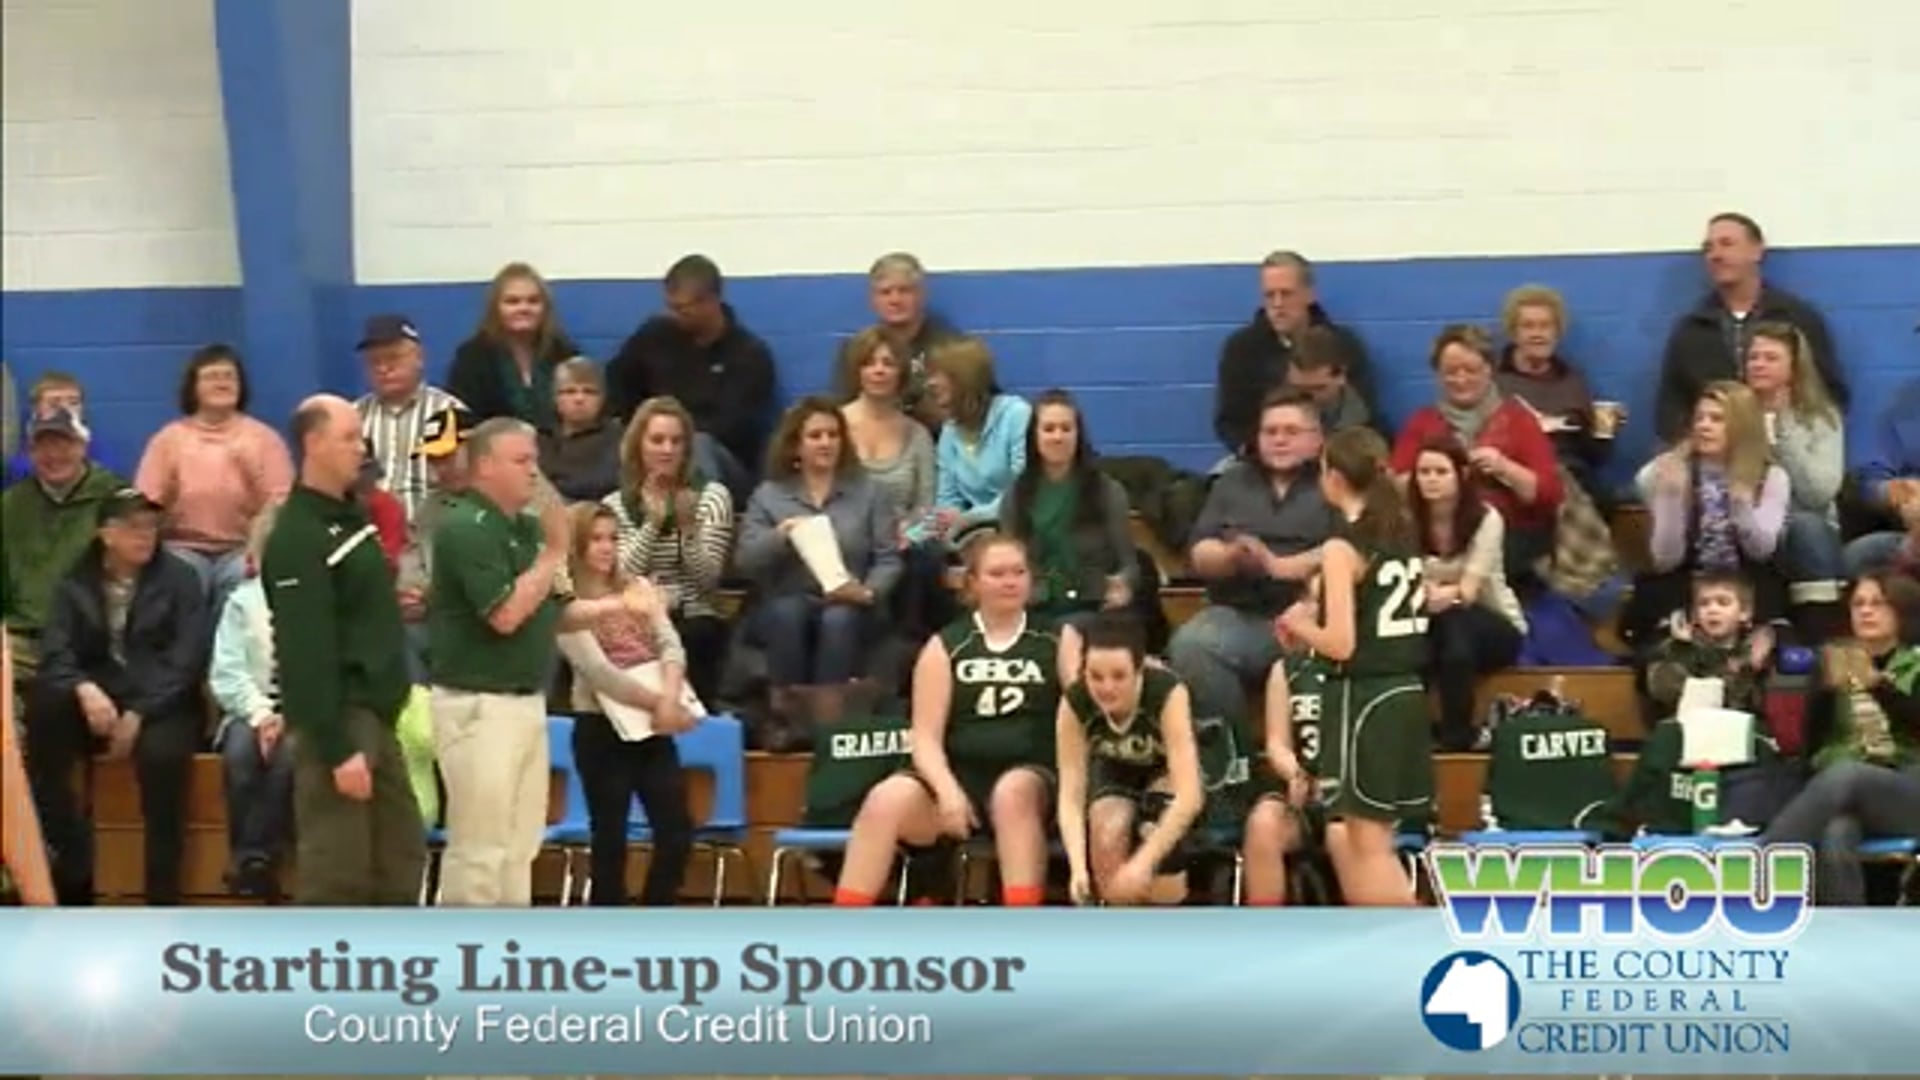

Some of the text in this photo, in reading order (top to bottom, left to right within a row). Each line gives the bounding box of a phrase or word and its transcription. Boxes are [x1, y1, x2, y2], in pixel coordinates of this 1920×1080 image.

[1376, 557, 1429, 636] 22
[976, 685, 1025, 717] 42
[1520, 729, 1606, 760] CARVER
[1694, 782, 1717, 810] G
